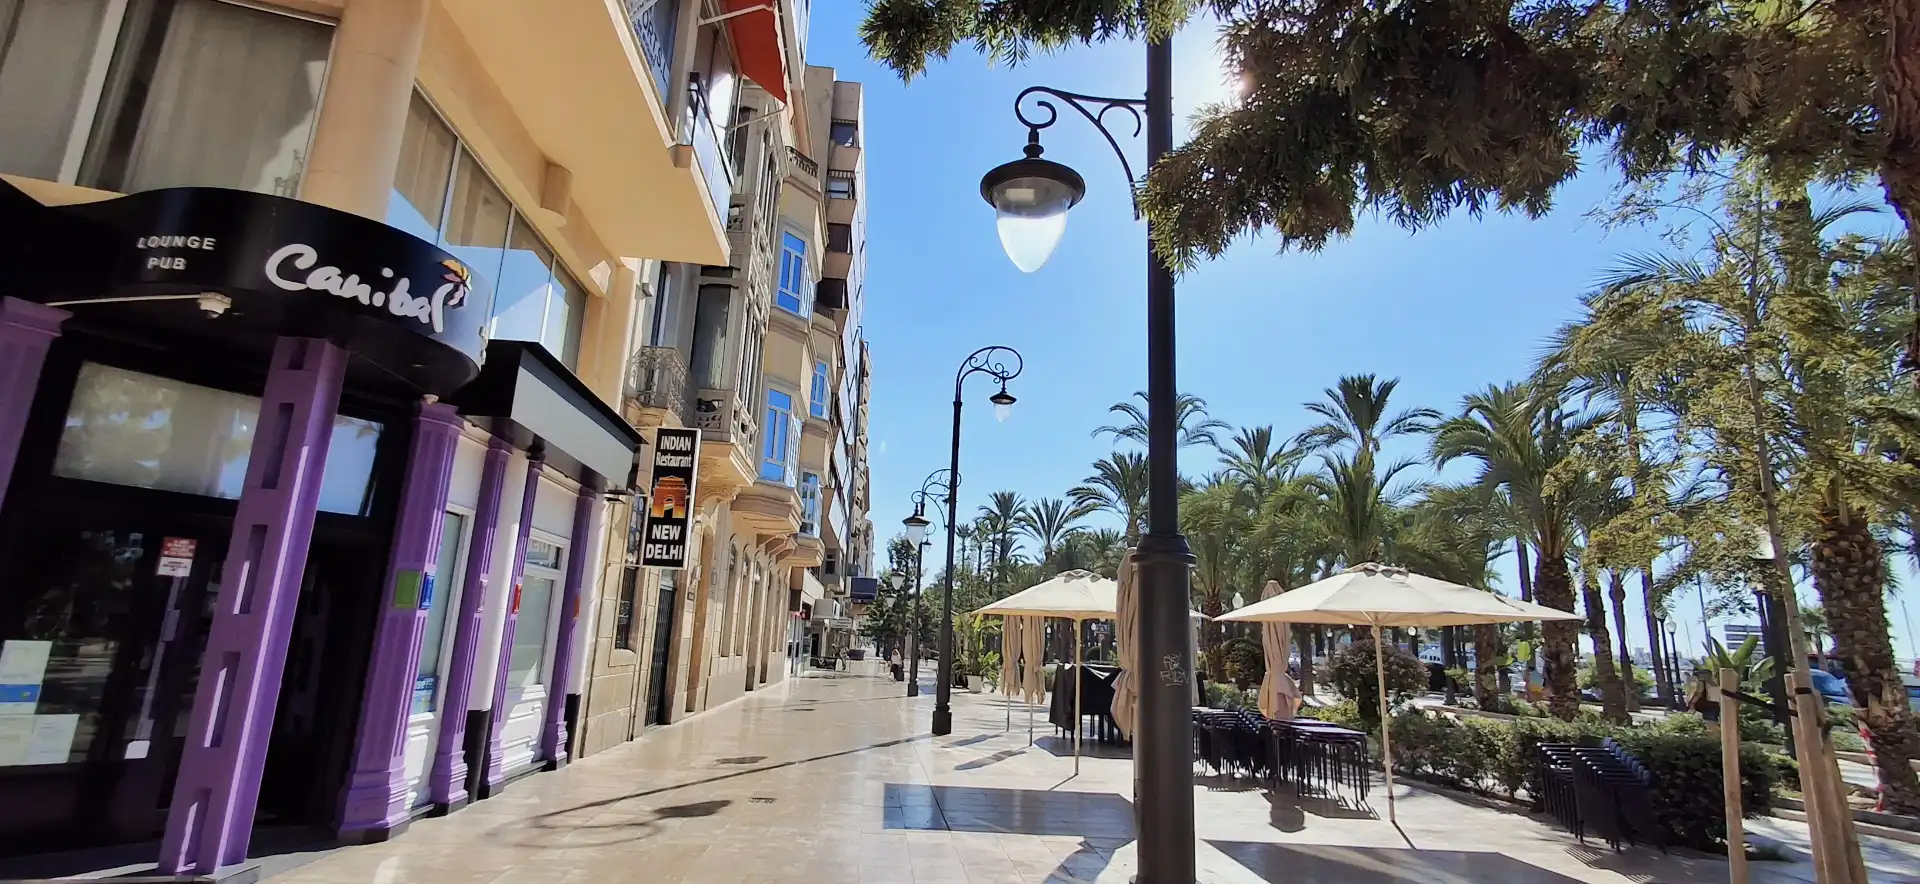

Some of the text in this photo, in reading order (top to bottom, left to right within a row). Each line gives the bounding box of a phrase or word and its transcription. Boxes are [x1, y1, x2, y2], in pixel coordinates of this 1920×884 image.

[136, 235, 217, 251] LOUNGE
[147, 256, 187, 270] PUB
[265, 243, 457, 333] Canibal
[660, 435, 692, 452] INDIAN
[655, 451, 692, 468] Restaurant
[651, 524, 681, 541] NEW
[645, 543, 684, 560] DELHI
